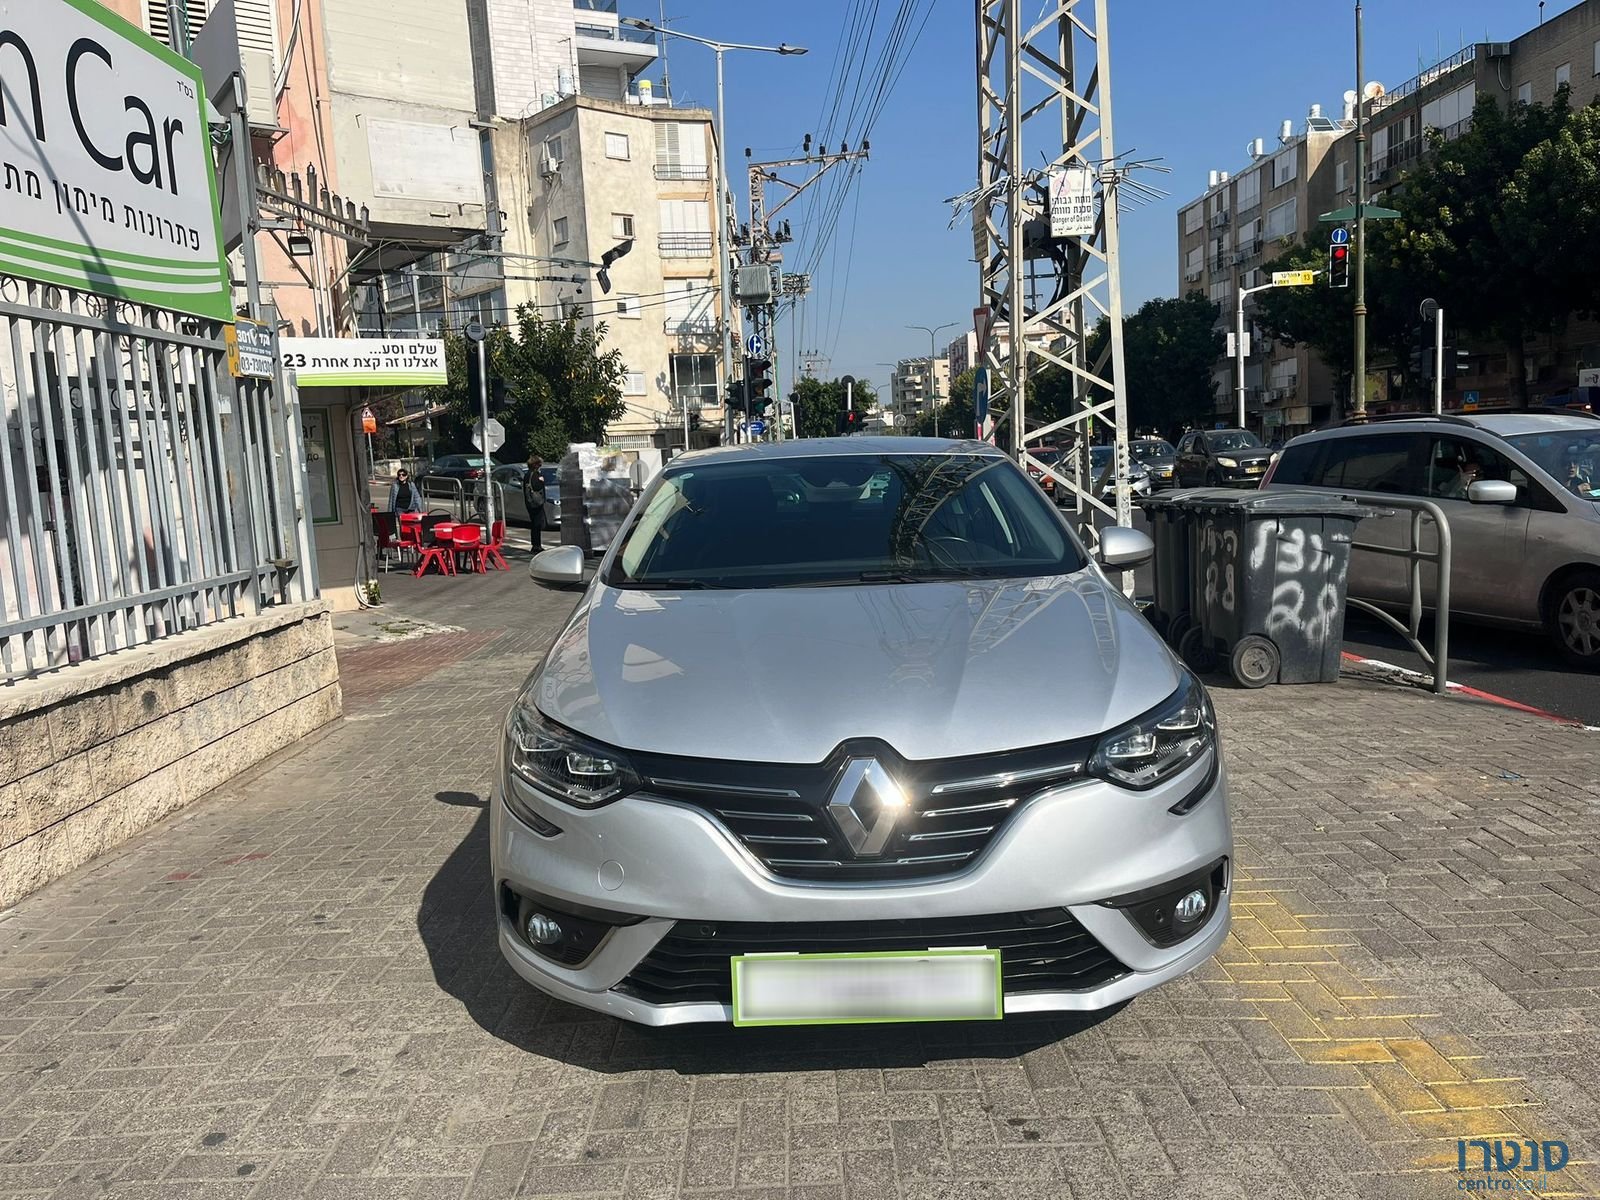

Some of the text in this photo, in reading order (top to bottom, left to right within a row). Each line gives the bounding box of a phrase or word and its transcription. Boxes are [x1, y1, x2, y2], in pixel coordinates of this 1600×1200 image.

[176, 80, 194, 100] בס"ד
[65, 37, 184, 196] Car
[52, 179, 115, 223] מימון
[123, 204, 200, 251] פתרונות
[1052, 216, 1069, 224] Danger
[236, 329, 252, 345] 301
[369, 342, 438, 355] שלם וסע...
[283, 353, 438, 371] אצלנו זה קצת אחרת 23
